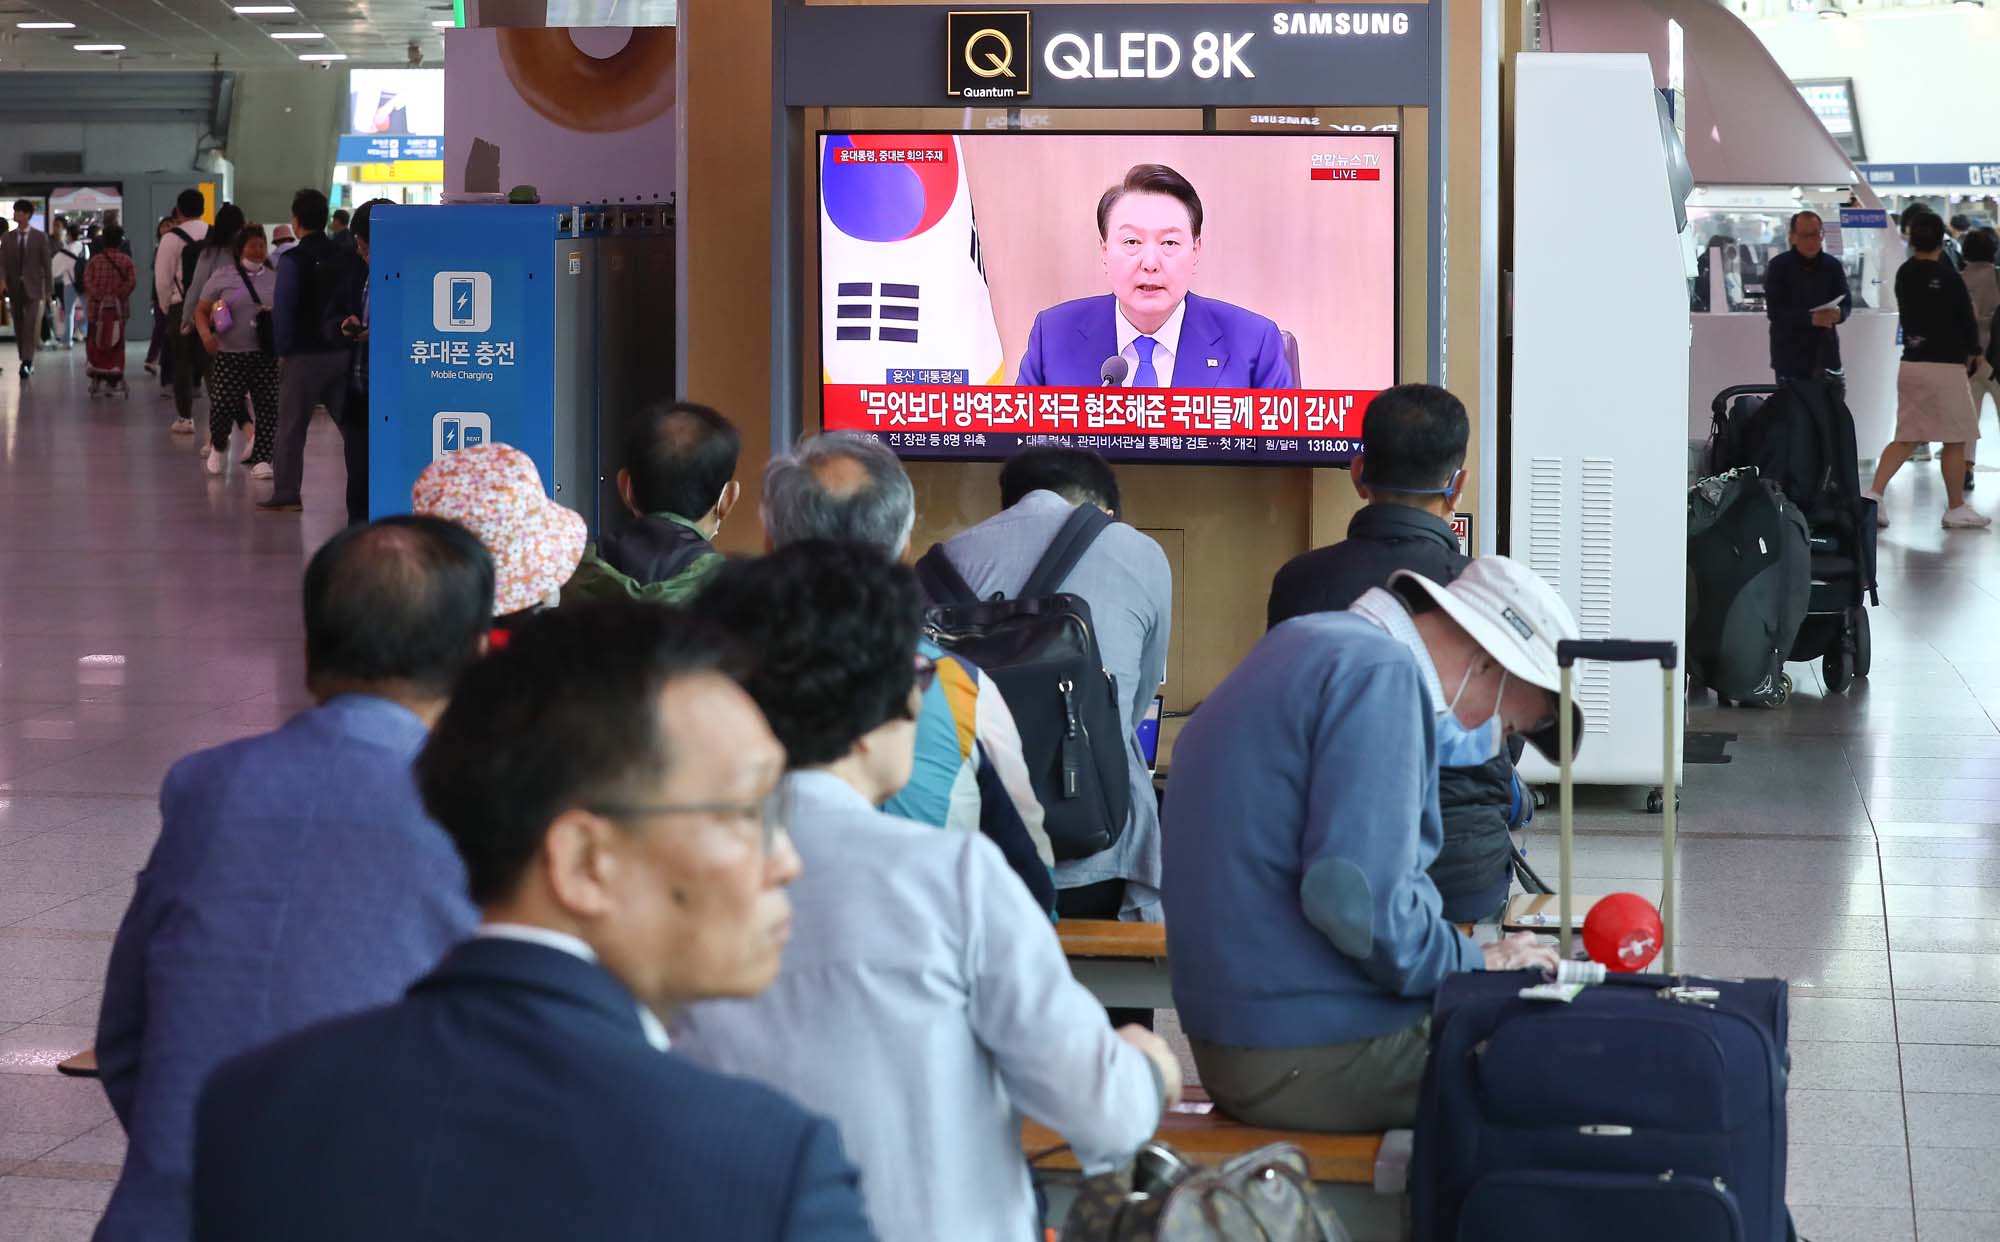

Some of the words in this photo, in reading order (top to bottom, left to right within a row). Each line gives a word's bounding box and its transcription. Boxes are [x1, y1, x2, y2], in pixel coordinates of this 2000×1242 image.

[1272, 12, 1409, 35] SAMSUNG
[964, 28, 1016, 78] Q
[1044, 32, 1181, 80] QLED
[1191, 32, 1256, 80] 8K
[963, 87, 1014, 98] Quantum
[840, 150, 878, 163] 윤대통령,
[879, 150, 905, 162] 중대본
[906, 150, 924, 162] 회의
[925, 150, 943, 162] 주재
[1332, 170, 1358, 179] LIVE
[410, 340, 471, 365] 휴대폰
[475, 341, 515, 366] 충전
[431, 370, 457, 379] Mobile
[458, 371, 494, 381] Charging
[892, 369, 916, 384] 용산
[918, 370, 963, 384] 대통령실
[859, 389, 948, 426] "무엇보다
[952, 391, 1034, 428] 방역조치
[1038, 393, 1080, 428] 적극
[1084, 393, 1166, 430] 협조해준
[1170, 394, 1254, 431] 국민들께
[1259, 395, 1299, 431] 깊이
[1304, 395, 1354, 432] 감사"
[889, 434, 901, 447] 전
[904, 434, 926, 447] 장관
[928, 434, 941, 447] 등
[943, 434, 961, 447] 8명
[963, 434, 987, 447] 위촉
[1077, 435, 1145, 449] 관리비서관실
[1148, 436, 1183, 450] 통폐합
[1265, 440, 1298, 451] 원/달러
[1307, 440, 1349, 452] 1318.00
